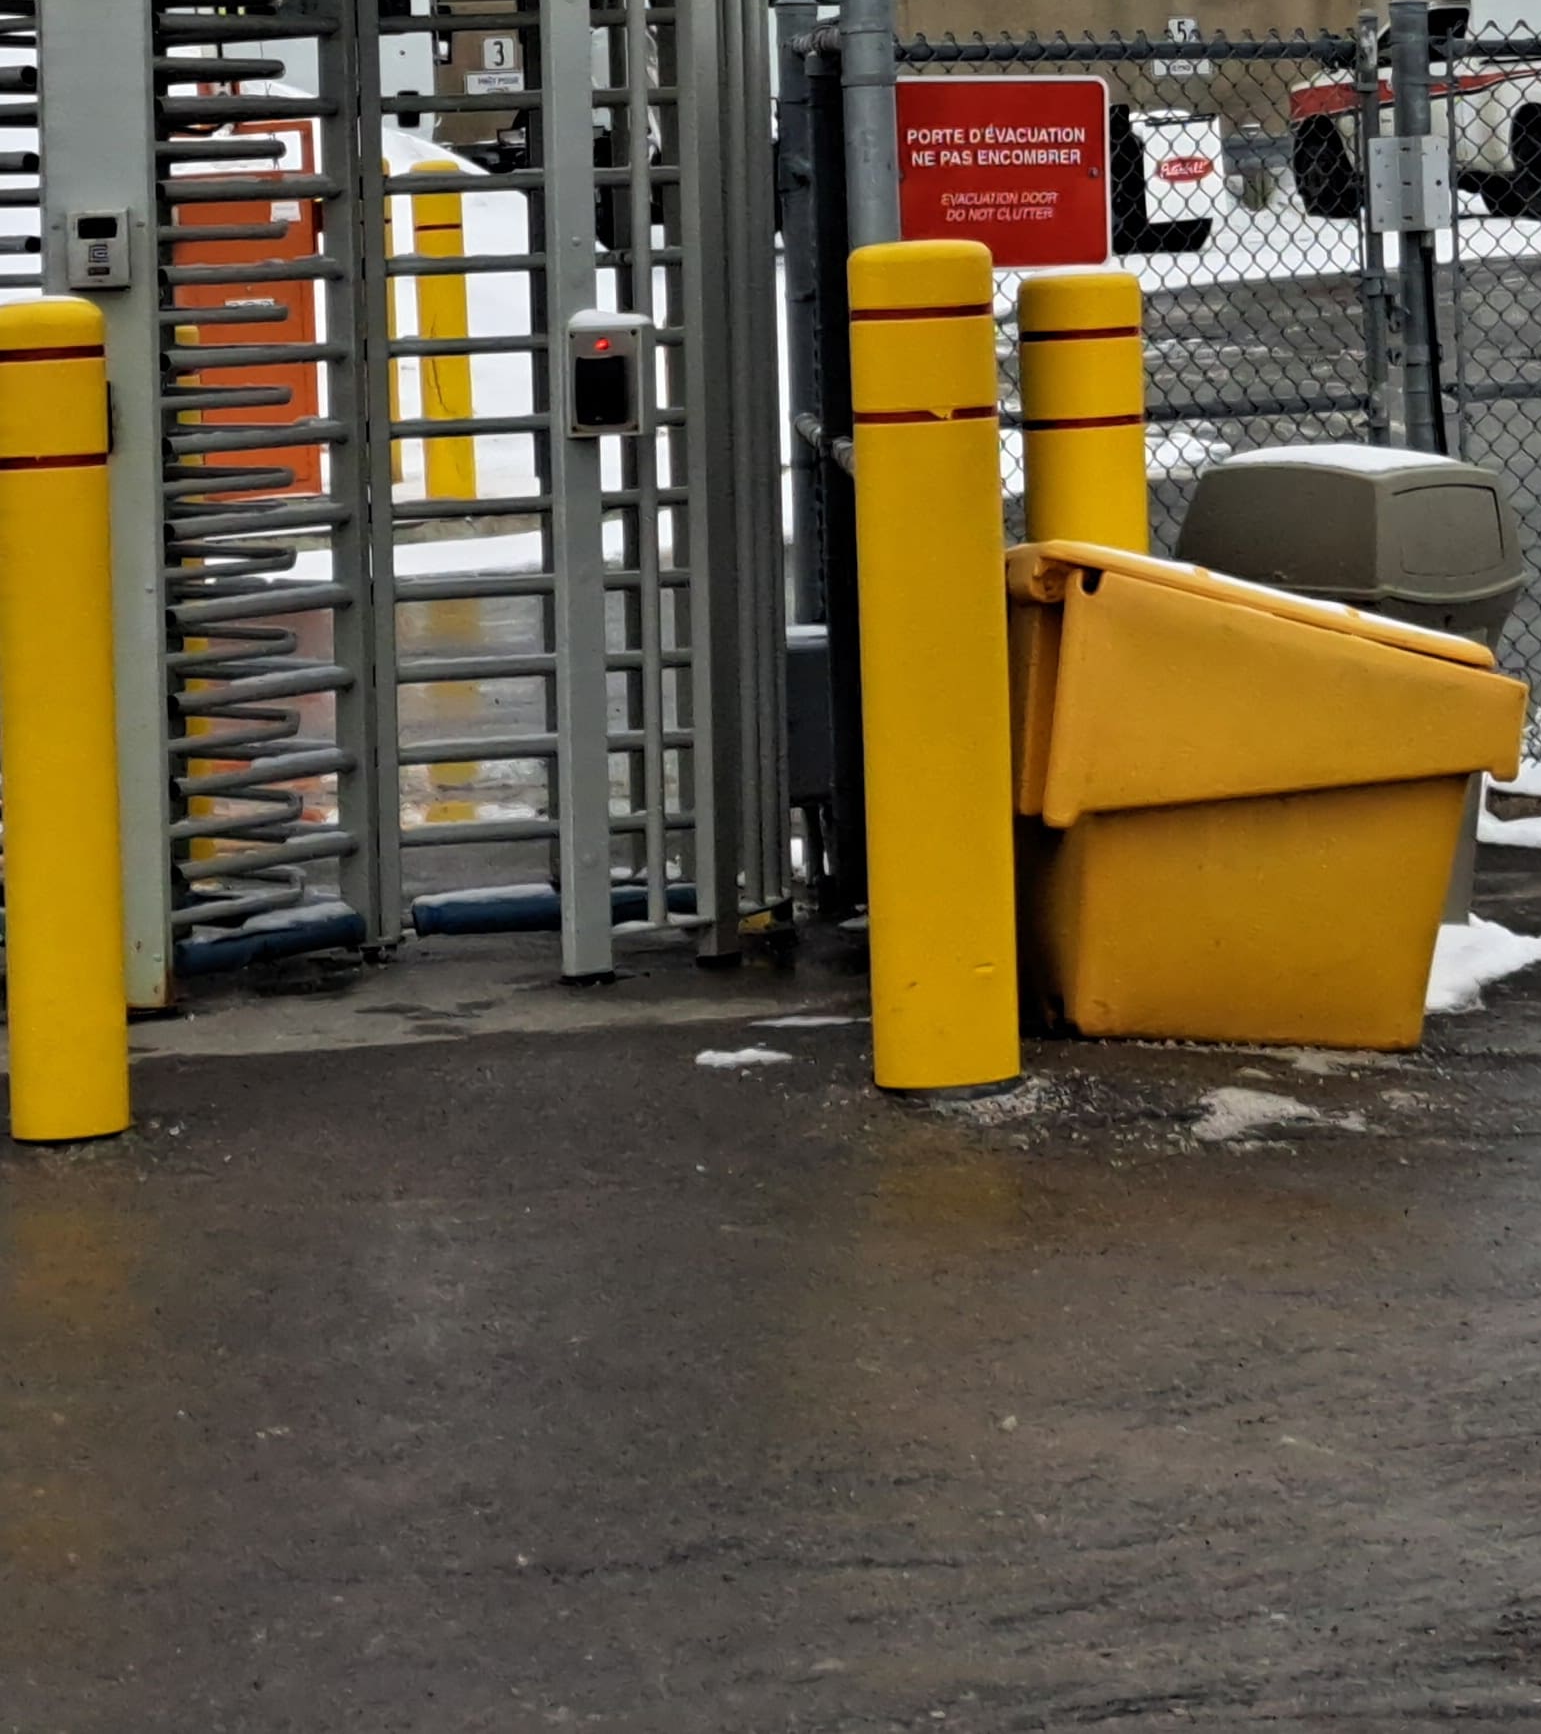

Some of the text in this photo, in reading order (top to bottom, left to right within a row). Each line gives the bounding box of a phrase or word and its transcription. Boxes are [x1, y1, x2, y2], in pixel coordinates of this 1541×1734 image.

[1177, 21, 1187, 42] 5
[492, 40, 505, 66] 3
[907, 124, 1085, 145] PORTE D'ÉVACUATION
[912, 148, 1081, 166] NE PAS ENCOMBRER
[941, 191, 1060, 207] EVACUATION DOOR
[946, 206, 1054, 222] DO NOT CLUTTER
